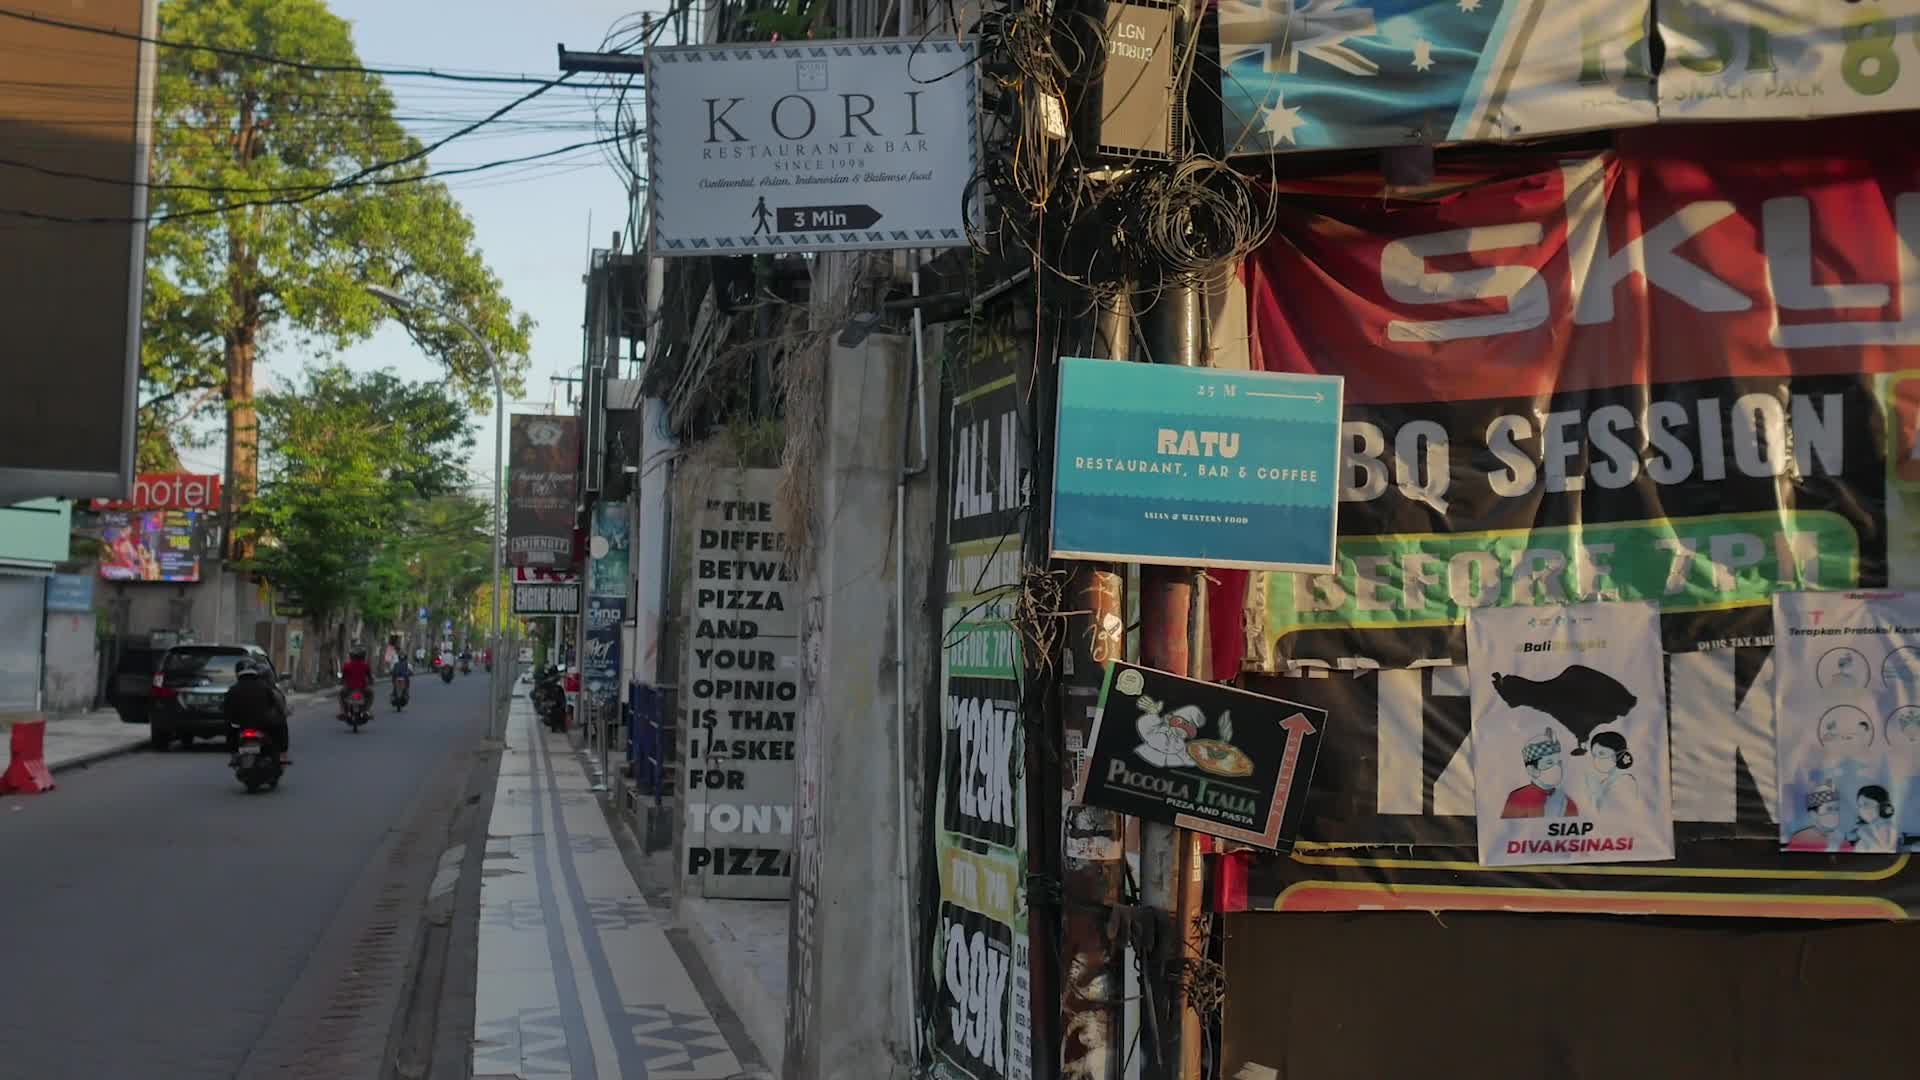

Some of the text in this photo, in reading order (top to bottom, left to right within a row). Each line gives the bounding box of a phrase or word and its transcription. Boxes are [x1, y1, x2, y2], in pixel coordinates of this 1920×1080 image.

[1117, 23, 1146, 40] LGN
[702, 91, 926, 143] KORI
[703, 140, 928, 159] RESTAURANT & BAR
[774, 159, 865, 171] SINCE 1998
[795, 173, 849, 185] Indonesian
[864, 171, 907, 182] Balinese
[793, 210, 848, 228] 3 Min
[1197, 384, 1237, 398] 25 M
[1157, 427, 1241, 459] RATU
[1485, 393, 1844, 498] SESSION
[954, 418, 993, 521] ALL
[1075, 456, 1318, 483] RESTAURANT, BAR & COFFEE
[133, 474, 211, 506] hotel
[1144, 511, 1169, 521] ASIAN
[1182, 513, 1222, 523] WESTERN
[1224, 515, 1248, 524] FOOD
[1294, 543, 1617, 612] BEFORE
[516, 585, 578, 612] ENGINE ROOM
[698, 589, 784, 611] PIZZA
[696, 619, 759, 639] AND
[695, 648, 775, 671] YOUR
[951, 629, 990, 668] BEFORE
[693, 680, 796, 701] OPINIO
[692, 708, 796, 731] IS THAT
[690, 739, 699, 759] I
[958, 697, 1016, 828] 129K
[689, 769, 745, 790] FOR
[688, 803, 793, 833] TONY
[1166, 797, 1254, 826] PIZZA AND PASTA
[1547, 822, 1594, 837] SIAP
[1506, 837, 1634, 854] DIVAKSINASI
[946, 922, 1010, 1077] 99K
